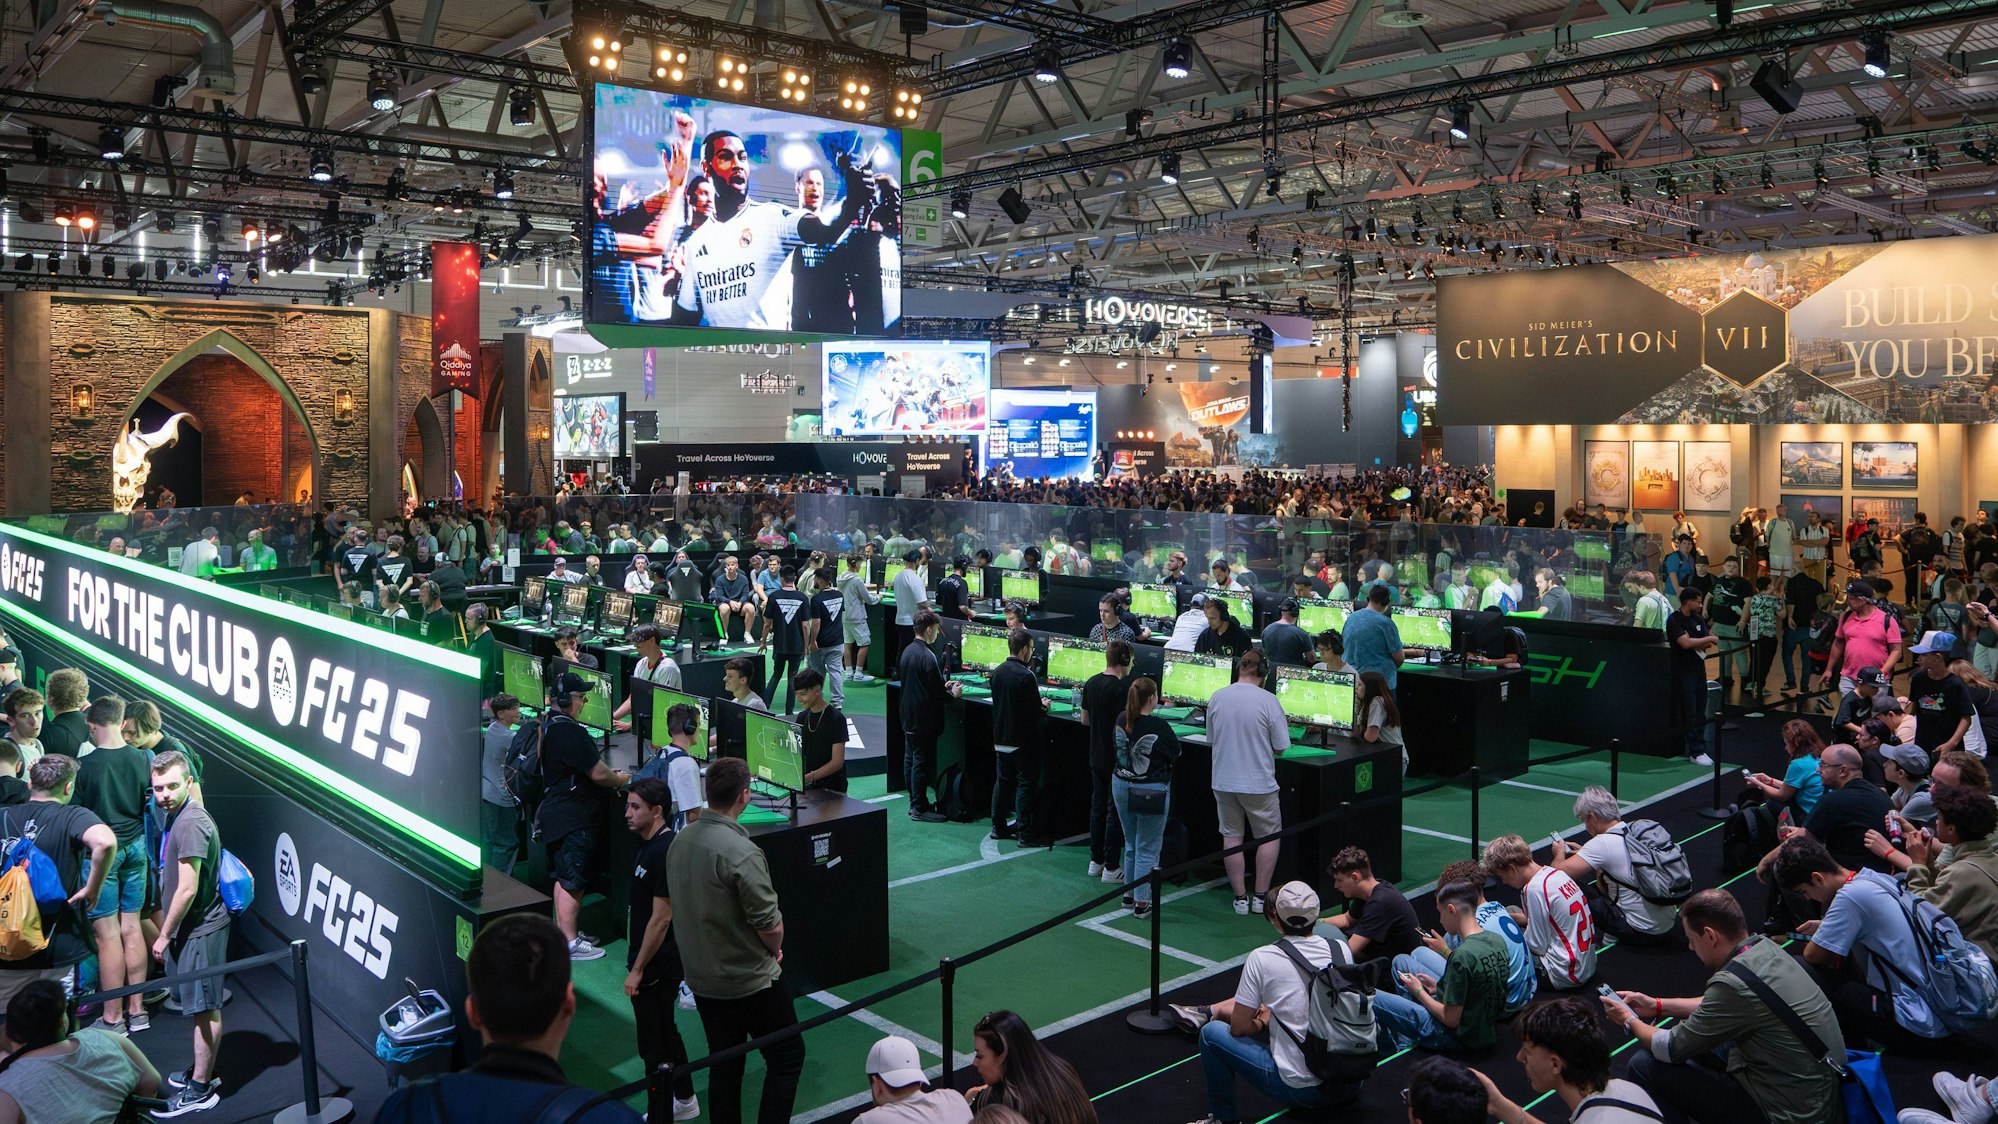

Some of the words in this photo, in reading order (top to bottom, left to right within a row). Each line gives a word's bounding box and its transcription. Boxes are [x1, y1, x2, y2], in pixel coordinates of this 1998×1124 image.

[910, 149, 936, 194] 6
[697, 261, 756, 290] Emirates
[706, 290, 718, 305] FLY
[719, 282, 747, 301] BETTER
[1842, 283, 1974, 329] BUILD
[1085, 296, 1208, 328] HOYOVERSE
[1528, 322, 1546, 331] SID
[1550, 319, 1594, 330] MEIER'S
[1455, 329, 1678, 360] CIVILIZATION
[1717, 325, 1768, 351] VII
[440, 360, 472, 370] Qiddiya
[1842, 338, 1932, 380] YOU
[1191, 399, 1247, 421] OUTLAWS
[676, 454, 703, 463] Travel
[704, 454, 732, 462] Across
[733, 453, 775, 462] HoYoverse
[906, 452, 928, 460] Travel
[928, 452, 950, 460] Across
[906, 462, 941, 471] HoYoverse
[68, 566, 111, 640] FOR
[113, 581, 165, 666] THE
[168, 603, 261, 709] CLUB
[273, 655, 291, 689] EA
[299, 657, 356, 744] FC
[351, 677, 431, 777] 25
[279, 849, 296, 884] EA
[461, 933, 469, 949] 12
